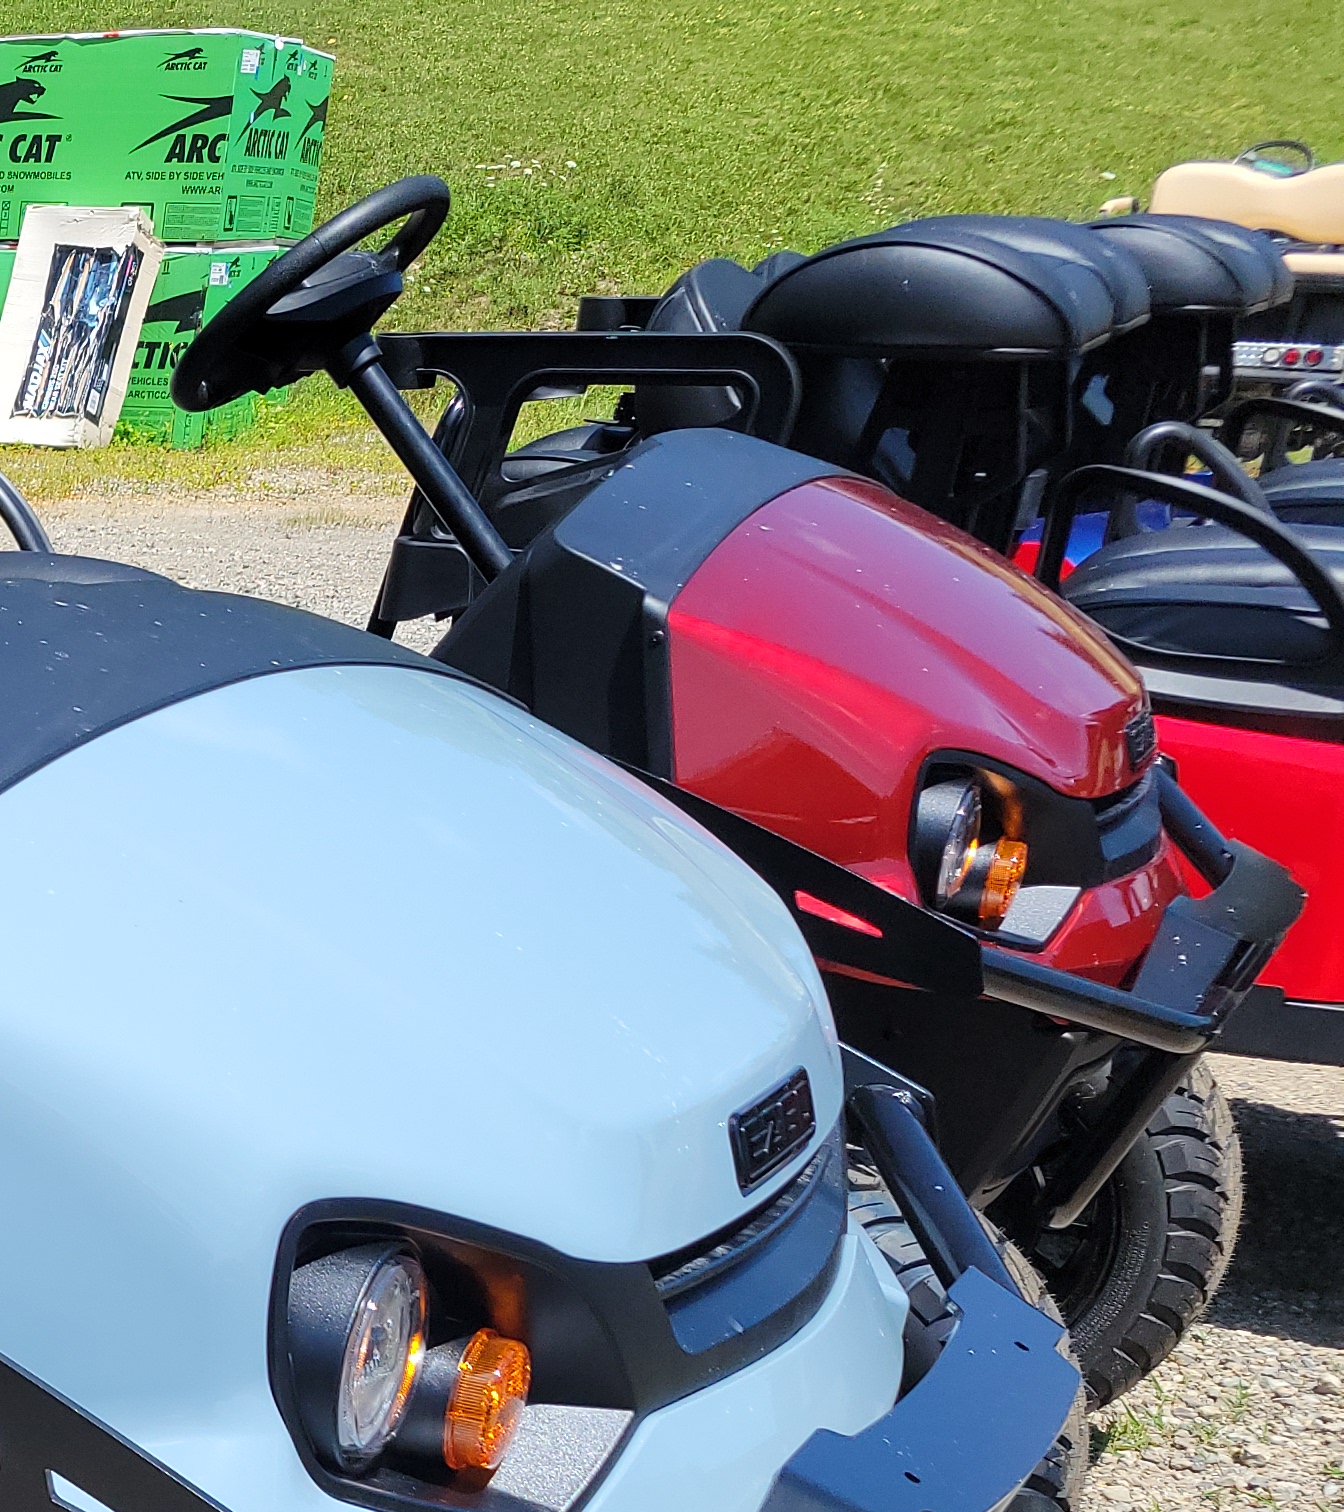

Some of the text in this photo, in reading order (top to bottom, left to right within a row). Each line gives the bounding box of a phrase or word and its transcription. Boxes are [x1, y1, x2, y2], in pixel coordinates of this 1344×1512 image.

[22, 64, 62, 73] ARCTIC CAT
[165, 62, 208, 71] ARCTIC CAT
[244, 127, 290, 160] ARCTIC CAT
[9, 134, 62, 163] CAT
[164, 134, 230, 163] ARC
[7, 171, 72, 180] SNOWMOBILES
[125, 172, 143, 181] ATV,
[145, 172, 166, 180] SIDE
[168, 172, 181, 180] BY
[184, 172, 204, 180] SIDE
